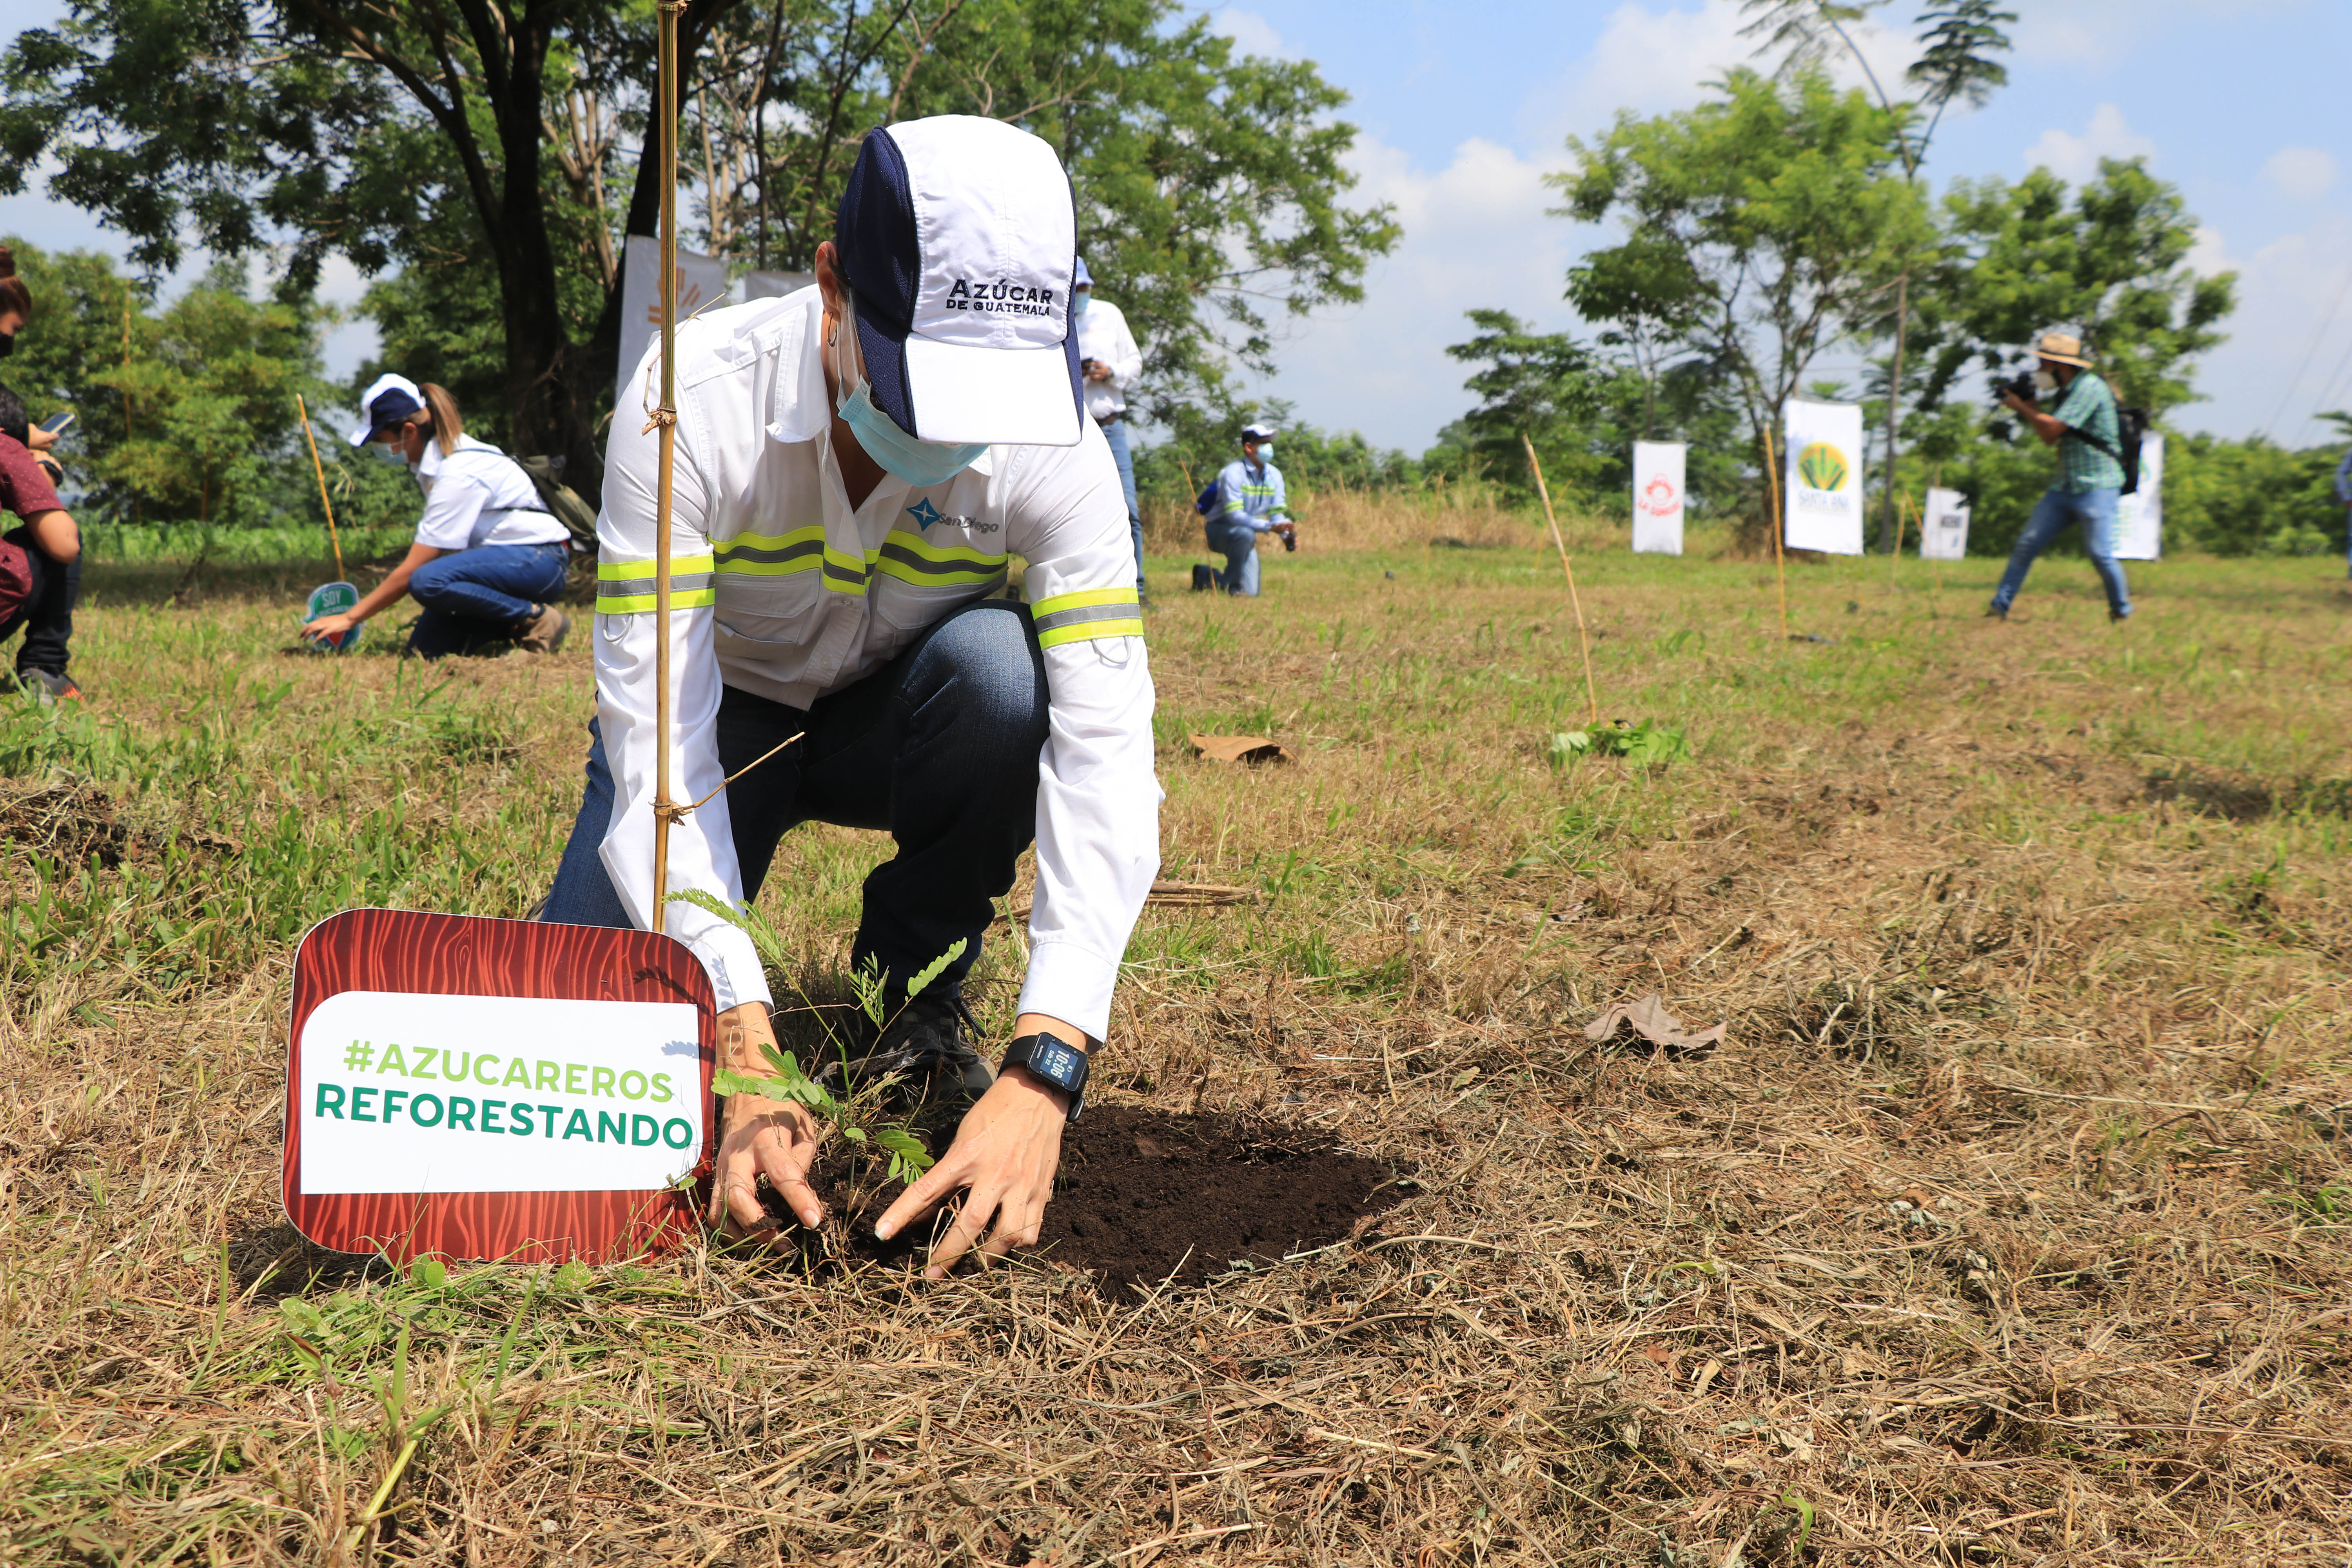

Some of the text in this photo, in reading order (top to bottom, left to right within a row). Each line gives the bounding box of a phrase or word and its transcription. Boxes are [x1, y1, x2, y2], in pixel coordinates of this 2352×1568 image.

[949, 279, 1053, 304] AZÚCAR
[946, 299, 1050, 316] DE GUATEMALA
[321, 590, 342, 607] SOY
[343, 1039, 673, 1103] #AZUCAREROS
[1051, 1050, 1070, 1078] 10:06
[315, 1083, 693, 1150] REFORESTANDO
